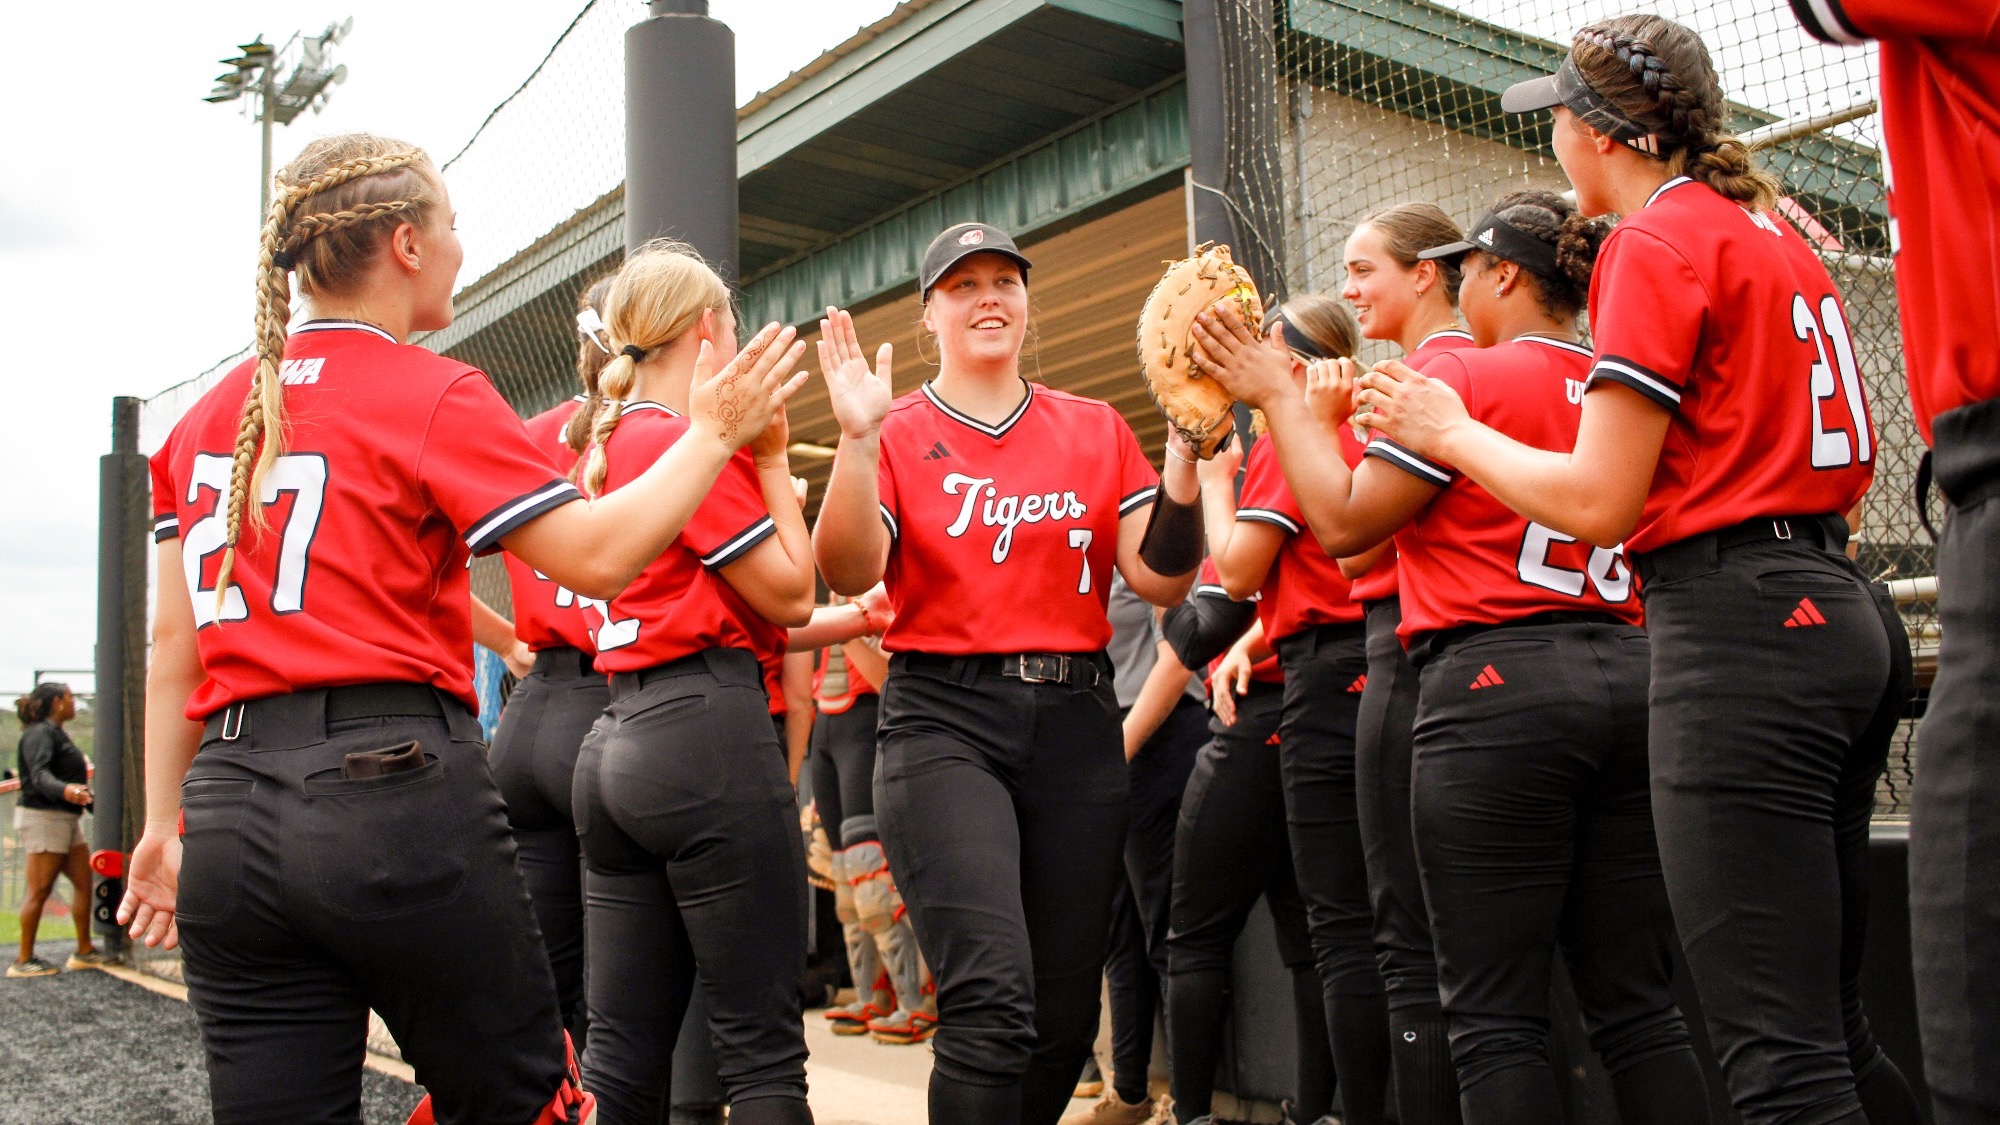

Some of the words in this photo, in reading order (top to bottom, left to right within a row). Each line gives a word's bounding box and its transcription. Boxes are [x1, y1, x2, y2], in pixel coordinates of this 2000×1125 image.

[1792, 291, 1873, 471] 21
[182, 452, 329, 632] 27
[941, 471, 1088, 565] Tigers
[1067, 527, 1093, 595] 7
